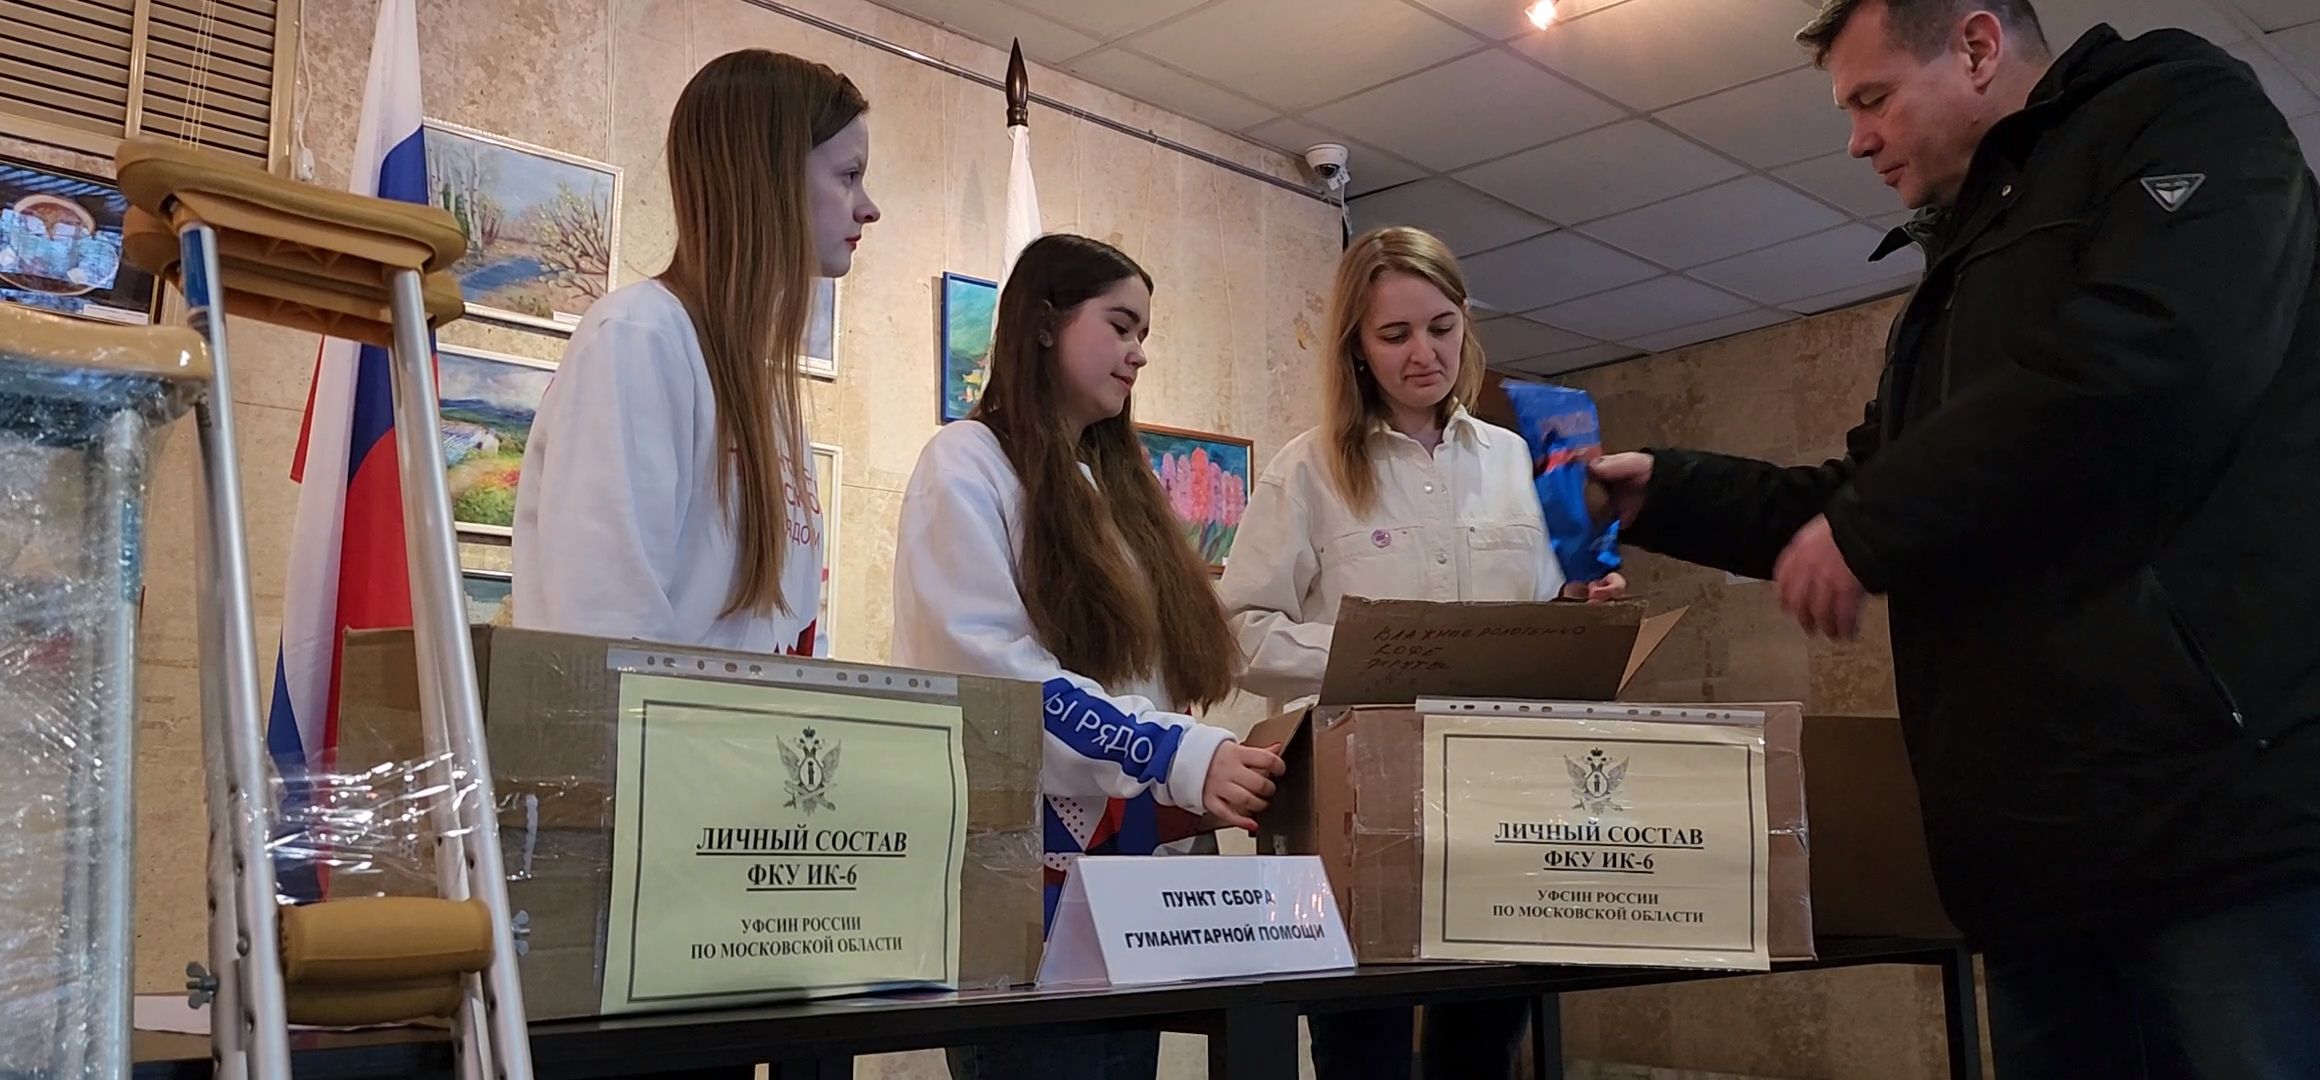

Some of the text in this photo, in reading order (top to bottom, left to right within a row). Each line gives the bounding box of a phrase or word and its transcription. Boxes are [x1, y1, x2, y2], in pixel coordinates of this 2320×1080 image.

[1044, 693, 1078, 722] Ы
[696, 824, 908, 853] ЛИЧНЫЙ СОСТАВ
[1494, 820, 1704, 846] ЛИЧНЫЙ СОСТАВ
[1543, 850, 1654, 871] ФКУ ИК-6
[746, 863, 858, 887] ФКУ ИК-6
[1160, 888, 1275, 909] ПУНКТ СБОРА
[1536, 889, 1659, 906] УФСИН РОССИИ
[740, 915, 862, 935] УФСИН РОССИИ
[1492, 903, 1704, 924] ПО МОСКОВСКОЙ ОБЛАСТИ
[690, 936, 903, 960] ПО МОСКОВСКОЙ ОБЛАСТИ
[1124, 923, 1326, 949] ГУМАНИТАРНОЙ ПОМОЩИ
